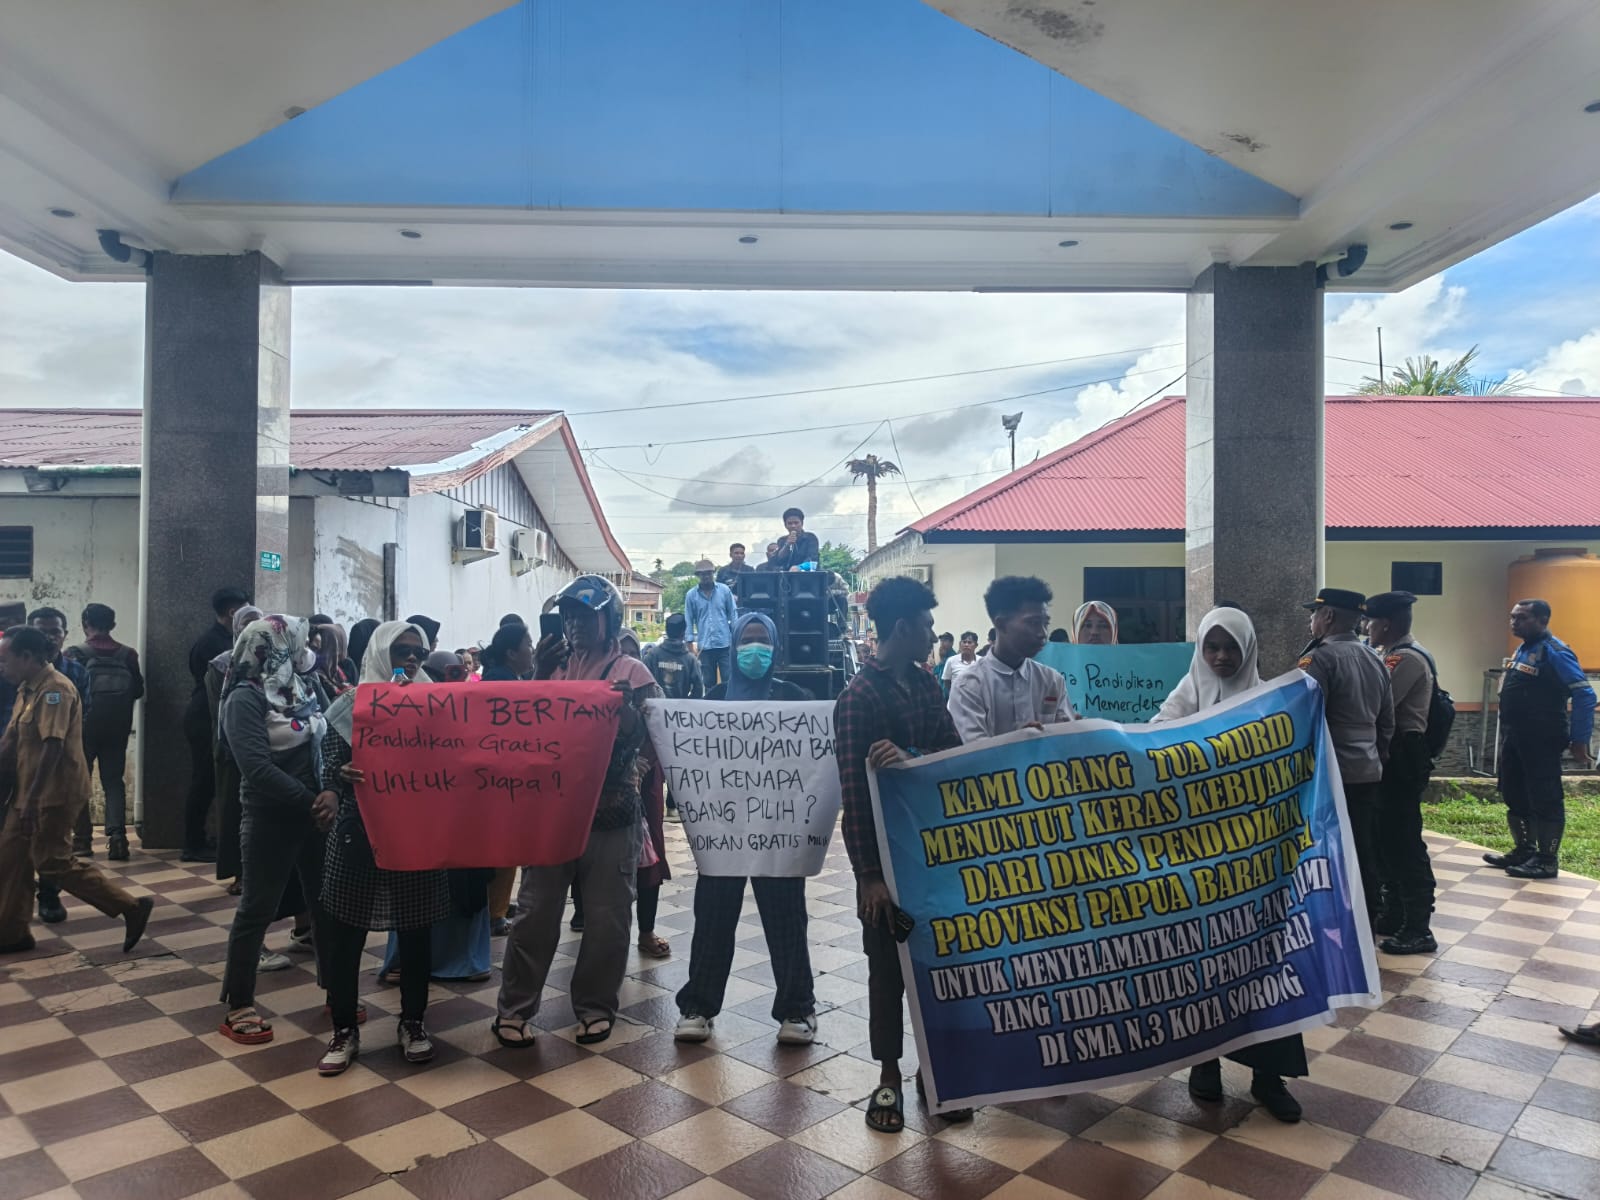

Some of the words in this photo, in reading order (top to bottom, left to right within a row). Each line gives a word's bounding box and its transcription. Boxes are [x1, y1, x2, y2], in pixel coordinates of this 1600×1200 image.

[1085, 663, 1164, 690] Pendidikan
[370, 689, 468, 724] KAMI
[664, 709, 829, 736] MENCERDASKAN
[358, 726, 464, 749] Pendidikan
[479, 734, 561, 760] Gratis
[673, 732, 802, 765] KEHIDUPAN
[664, 765, 711, 794] TAPI
[721, 768, 803, 792] KENAPA
[939, 769, 1022, 817] KAMI
[1026, 752, 1134, 800] ORANG
[1148, 741, 1209, 781] TUA
[1206, 712, 1293, 767] MURID
[371, 772, 456, 794] Untuk
[475, 768, 540, 800] Siapa
[552, 770, 562, 797] ?
[677, 800, 736, 824] EBANG
[747, 797, 794, 823] PILIH
[805, 795, 817, 824] ?
[921, 804, 1076, 866] MENUNTUT
[1080, 786, 1180, 837] KERAS
[1184, 745, 1315, 818] KEBIJAKAN
[748, 834, 801, 849] GRATIS
[961, 856, 1044, 904] DARI
[1047, 838, 1138, 888] DINAS
[1139, 793, 1305, 869] PENDIDIKAN
[931, 895, 1083, 955] PROVINSI
[1086, 874, 1191, 928] PAPUA
[1191, 846, 1276, 904] BARAT
[930, 959, 1010, 1000] UNTUK
[1010, 918, 1204, 989] MENYELAMATKAN
[986, 994, 1050, 1034] YANG
[1055, 977, 1132, 1023] TIDAK
[1133, 962, 1199, 1007] LULUS
[1038, 1032, 1070, 1067] DI
[1073, 1023, 1123, 1061] SMA
[1125, 1014, 1165, 1051] N.3
[1168, 994, 1227, 1041] KOTA
